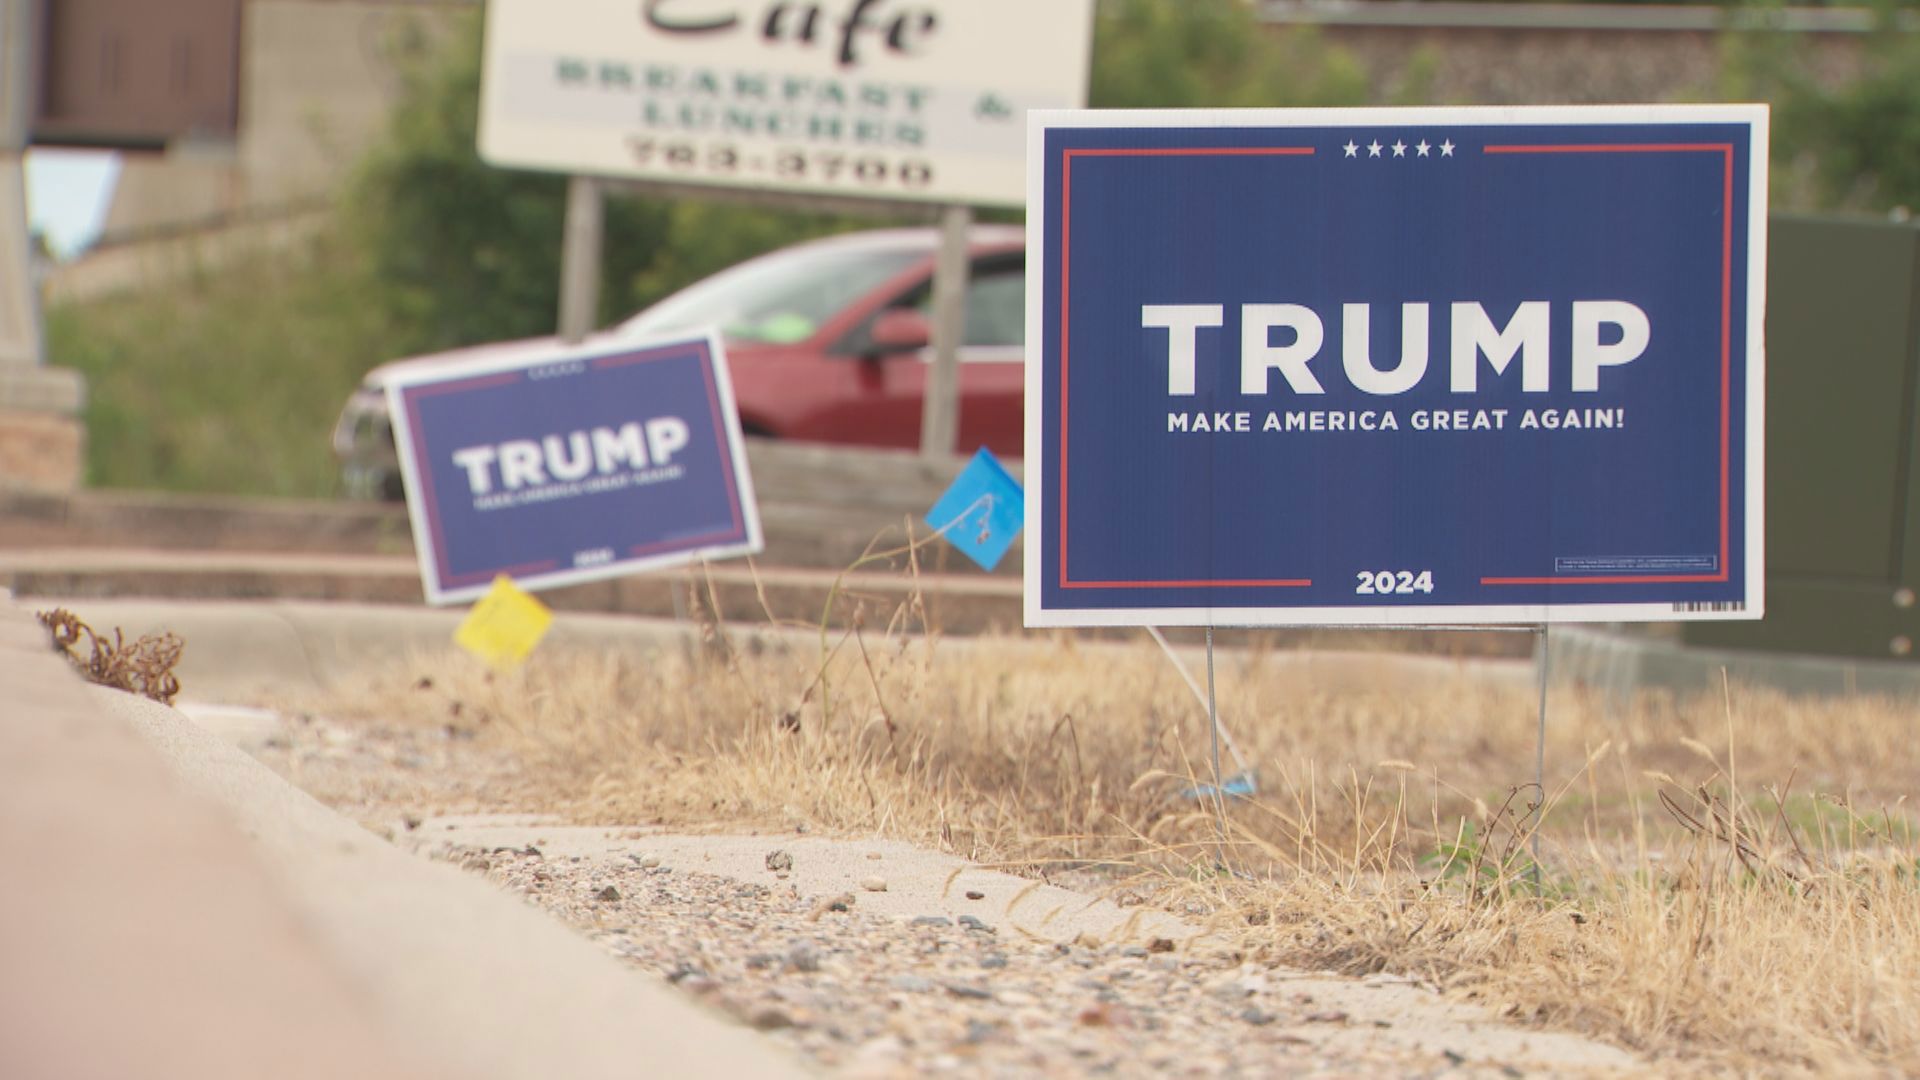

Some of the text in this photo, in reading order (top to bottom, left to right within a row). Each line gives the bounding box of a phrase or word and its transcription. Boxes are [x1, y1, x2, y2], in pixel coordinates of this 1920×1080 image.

[556, 57, 1013, 121] BREAKFAST &
[641, 99, 927, 145] LUNCHES
[1141, 300, 1651, 396] TRUMP
[1167, 408, 1625, 432] MAKE AMERICA GREAT AGAIN!
[453, 416, 689, 495] TRUMP
[1355, 570, 1434, 595] 2024
